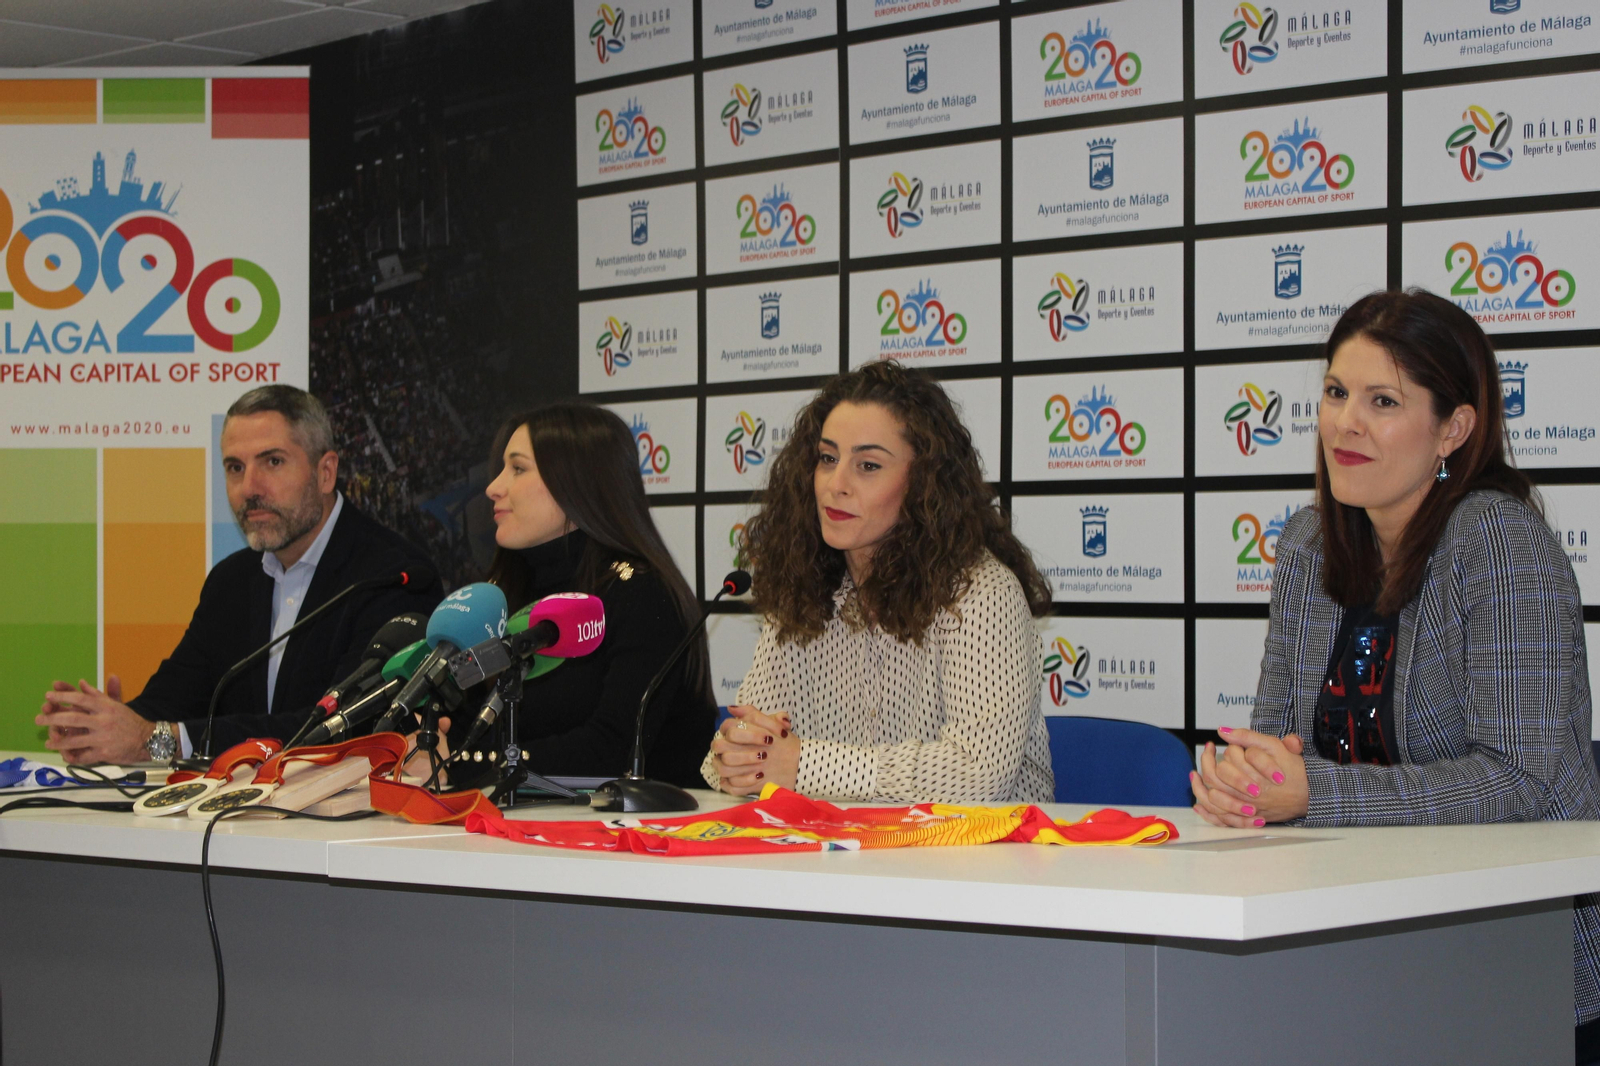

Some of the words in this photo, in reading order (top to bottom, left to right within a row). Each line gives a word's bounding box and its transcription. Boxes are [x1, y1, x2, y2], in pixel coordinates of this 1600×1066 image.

[714, 18, 770, 36] Ayuntamiento
[773, 13, 783, 24] de
[786, 8, 817, 22] Málaga
[1288, 10, 1351, 32] MÁLAGA
[1424, 24, 1515, 46] Ayuntamiento
[1520, 20, 1536, 33] de
[1541, 15, 1592, 30] Málaga
[1288, 36, 1314, 50] Deporte
[1324, 32, 1351, 43] Eventos
[1460, 38, 1552, 56] #malagafunciona
[1040, 32, 1142, 90] 2020
[1044, 80, 1094, 97] MÁLAGA
[768, 90, 813, 110] MÁLAGA
[1044, 96, 1080, 108] EUROPEAN
[1081, 93, 1108, 103] CAPITAL
[1121, 88, 1142, 98] SPORT
[861, 102, 924, 121] Ayuntamiento
[927, 99, 938, 110] de
[942, 94, 976, 108] Málaga
[886, 114, 950, 129] #malagafunciona
[1524, 118, 1596, 139] MÁLAGA
[596, 109, 666, 158] 2020
[1524, 144, 1554, 158] Deporte
[1566, 140, 1596, 152] Eventos
[1240, 130, 1354, 193] 2020
[930, 182, 981, 200] MÁLAGA
[1244, 182, 1300, 198] MÁLAGA
[930, 204, 951, 217] Deporte
[960, 202, 981, 212] Eventos
[1038, 200, 1110, 216] Ayuntamiento
[1113, 196, 1126, 208] de
[1130, 193, 1170, 208] Málaga
[1244, 199, 1284, 210] EUROPEAN
[1286, 197, 1316, 206] CAPITAL
[1318, 196, 1328, 204] OF
[1331, 192, 1354, 202] SPORT
[736, 194, 816, 248] 2020
[1066, 213, 1139, 228] #malagafunciona
[740, 238, 779, 252] MÁLAGA
[596, 253, 645, 268] Ayuntamiento
[648, 250, 656, 260] de
[659, 247, 686, 259] Málaga
[0, 188, 280, 353] 020
[1445, 242, 1576, 309] 2020
[1098, 286, 1155, 304] MÁLAGA
[877, 289, 967, 346] 2020
[1098, 308, 1122, 321] Deporte
[1130, 306, 1154, 316] Eventos
[1216, 308, 1296, 326] Ayuntamiento
[1300, 306, 1315, 318] de
[1498, 312, 1531, 322] CAPITAL
[1534, 311, 1546, 320] OF
[1548, 310, 1576, 320] SPORT
[0, 320, 111, 354] LAGA
[1248, 322, 1330, 338] #malagafunciona
[721, 346, 776, 362] Ayuntamiento
[779, 344, 789, 355] de
[792, 342, 822, 355] Málaga
[880, 336, 924, 350] MÁLAGA
[0, 362, 61, 383] PEAN
[70, 362, 161, 384] CAPITAL
[169, 362, 200, 383] OF
[208, 362, 280, 382] SPORT
[11, 422, 191, 437] www.malaga2020.eu
[1045, 394, 1146, 456] 2020
[1524, 427, 1540, 440] de
[1546, 426, 1596, 442] Málaga
[1048, 444, 1097, 458] MÁLAGA
[1048, 461, 1083, 470] EUROPEAN
[1086, 460, 1111, 468] CAPITAL
[1114, 460, 1123, 468] OF
[1125, 458, 1146, 467] SPORT
[1106, 566, 1119, 577] de
[1122, 564, 1162, 579] Málaga
[1237, 564, 1273, 580] MÁLA
[1060, 582, 1132, 594] #malagafunciona
[1099, 656, 1155, 674] MÁLAGA
[1099, 678, 1122, 690] Deporte
[1130, 679, 1155, 690] Eventos
